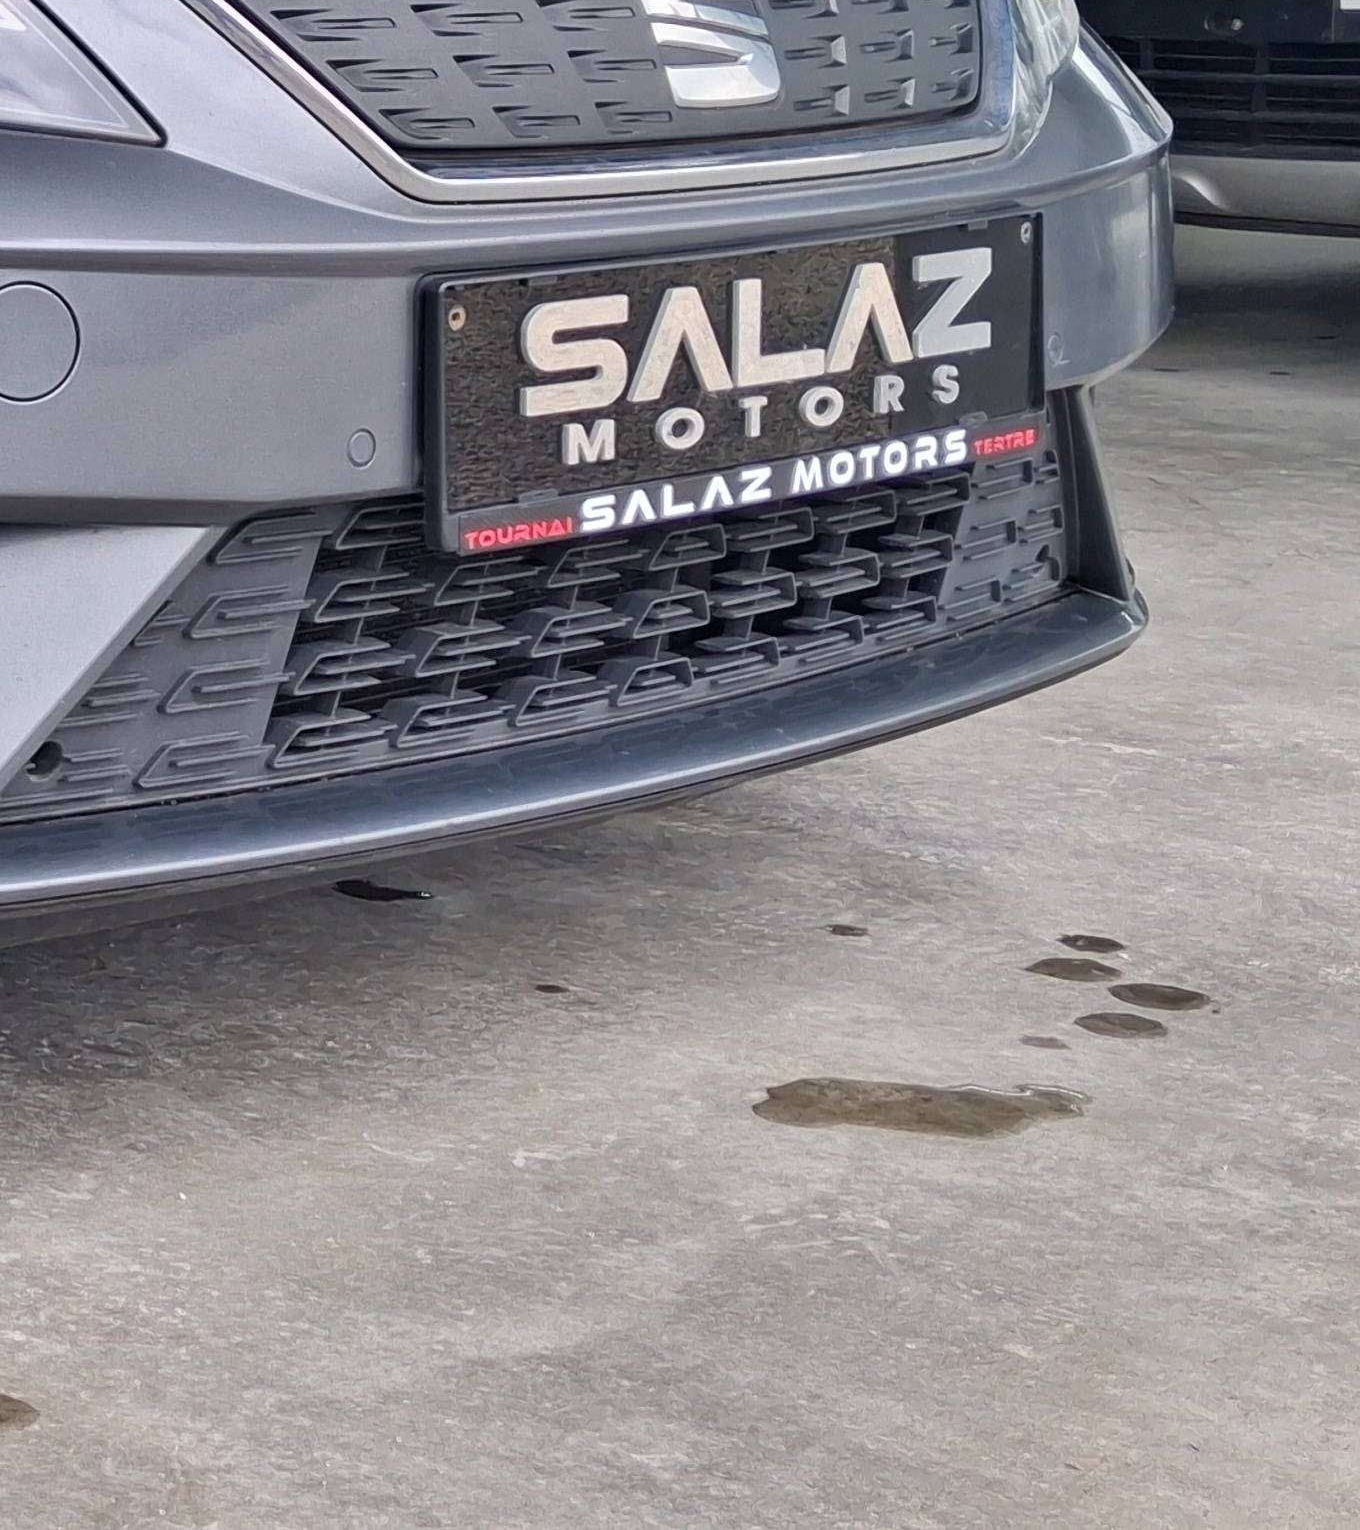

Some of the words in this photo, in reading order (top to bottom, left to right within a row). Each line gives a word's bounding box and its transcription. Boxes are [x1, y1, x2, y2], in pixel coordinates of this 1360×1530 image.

[519, 247, 993, 417] SALAZ
[561, 364, 961, 466] MOTORS
[464, 516, 573, 551] TOURNAI
[581, 466, 774, 532] SALAZ
[790, 429, 968, 494] MOTORS
[974, 428, 1036, 456] TERTRE
